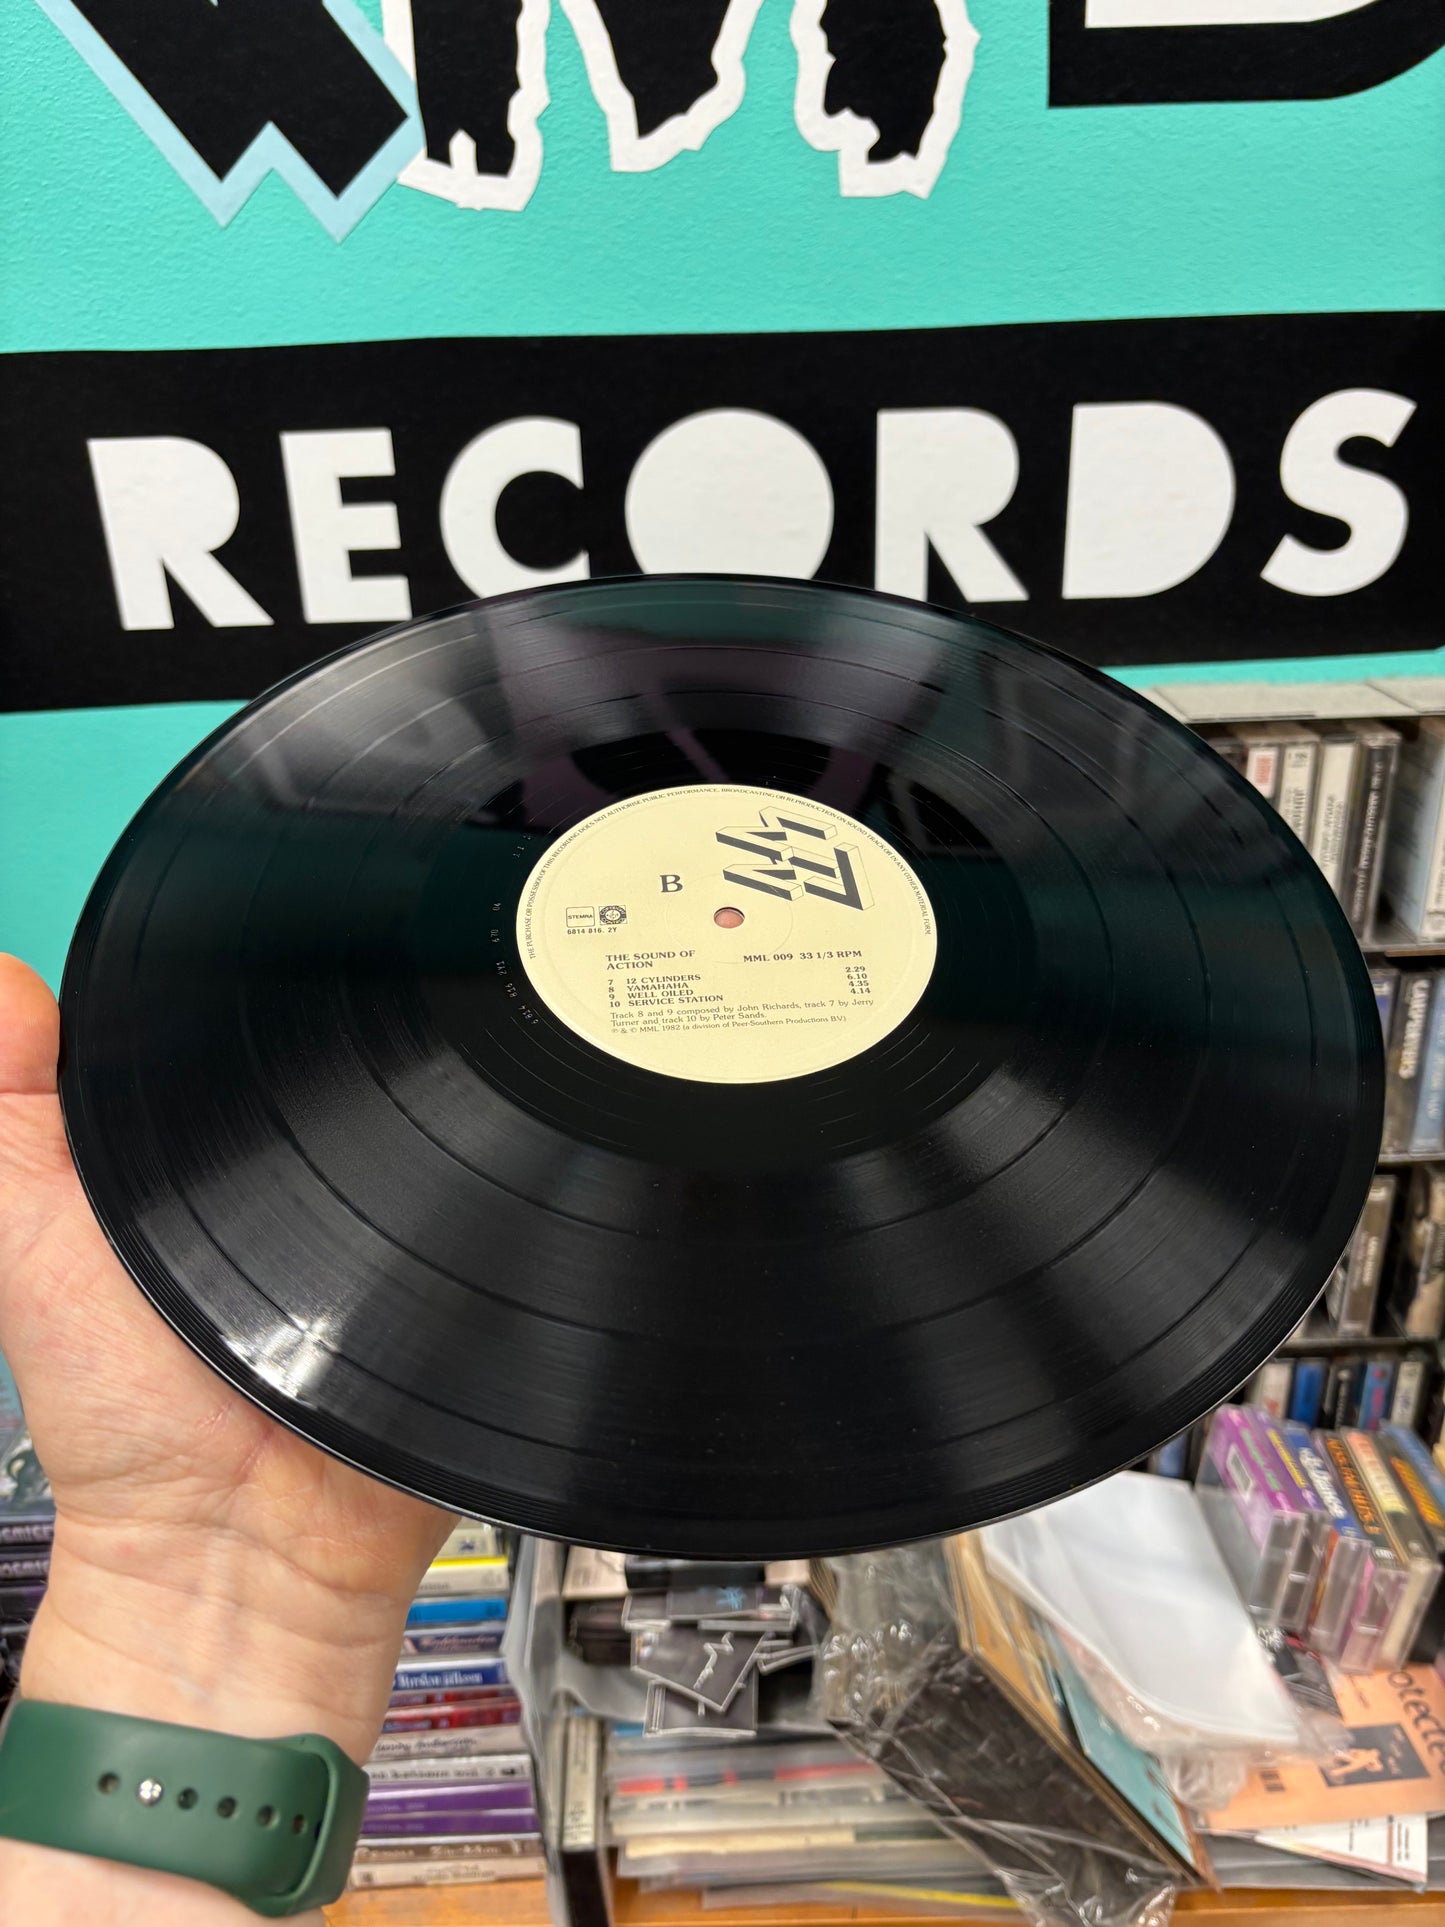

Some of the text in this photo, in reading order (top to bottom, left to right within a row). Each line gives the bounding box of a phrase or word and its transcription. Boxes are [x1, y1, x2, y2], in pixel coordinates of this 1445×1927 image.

[88, 388, 1416, 630] RECORDS
[642, 793, 666, 803] PUBLIC
[721, 788, 775, 799] BROADCASTING
[607, 799, 643, 817] AUTHORISE
[786, 796, 837, 818] REPRODUCTION
[593, 814, 608, 824] NOT
[578, 821, 595, 834] DOES
[846, 821, 868, 836] SOUND
[552, 830, 580, 859] RECORDING
[867, 833, 885, 850] TRACK
[883, 848, 892, 856] OR
[543, 857, 555, 869] THIS
[896, 861, 907, 872] ANY
[539, 867, 547, 876] OF
[659, 874, 684, 894] B
[904, 872, 918, 892] OTHER
[527, 875, 543, 908] POSSESSION
[914, 890, 929, 917] MATERIAL
[526, 908, 533, 917] OR
[525, 917, 534, 947] PURCHASE
[527, 948, 536, 959] THE
[605, 950, 696, 962] THE SOUND OF
[743, 950, 862, 963] MML 009 33 1/3 RPM
[606, 961, 653, 970] ACTION
[626, 977, 637, 985] 12
[640, 974, 701, 984] CYLINDERS
[626, 982, 689, 992] YAMAHAHA
[850, 987, 871, 995] 4.14
[627, 991, 658, 999] WELL
[661, 989, 694, 997] OILED
[628, 998, 675, 1007] SERVICE
[678, 994, 724, 1004] STATION
[610, 1011, 634, 1019] Track
[637, 1010, 644, 1018] 8
[647, 1009, 664, 1017] and
[676, 1006, 720, 1017] composed
[723, 1005, 735, 1014] by
[737, 1004, 759, 1012] John
[762, 1002, 802, 1011] Richards,
[829, 999, 835, 1007] 7
[838, 999, 849, 1008] by
[851, 998, 874, 1007] Jerry
[610, 1019, 640, 1027] Turner
[642, 1017, 660, 1025] and
[661, 1016, 684, 1024] track
[686, 1015, 697, 1023] 10
[699, 1014, 710, 1023] by
[712, 1012, 736, 1021] Peter
[662, 1024, 681, 1032] 1982
[691, 1022, 721, 1030] division
[722, 1021, 730, 1029] of
[731, 1017, 784, 1028] Peer-Southern
[786, 1016, 829, 1025] Productions
